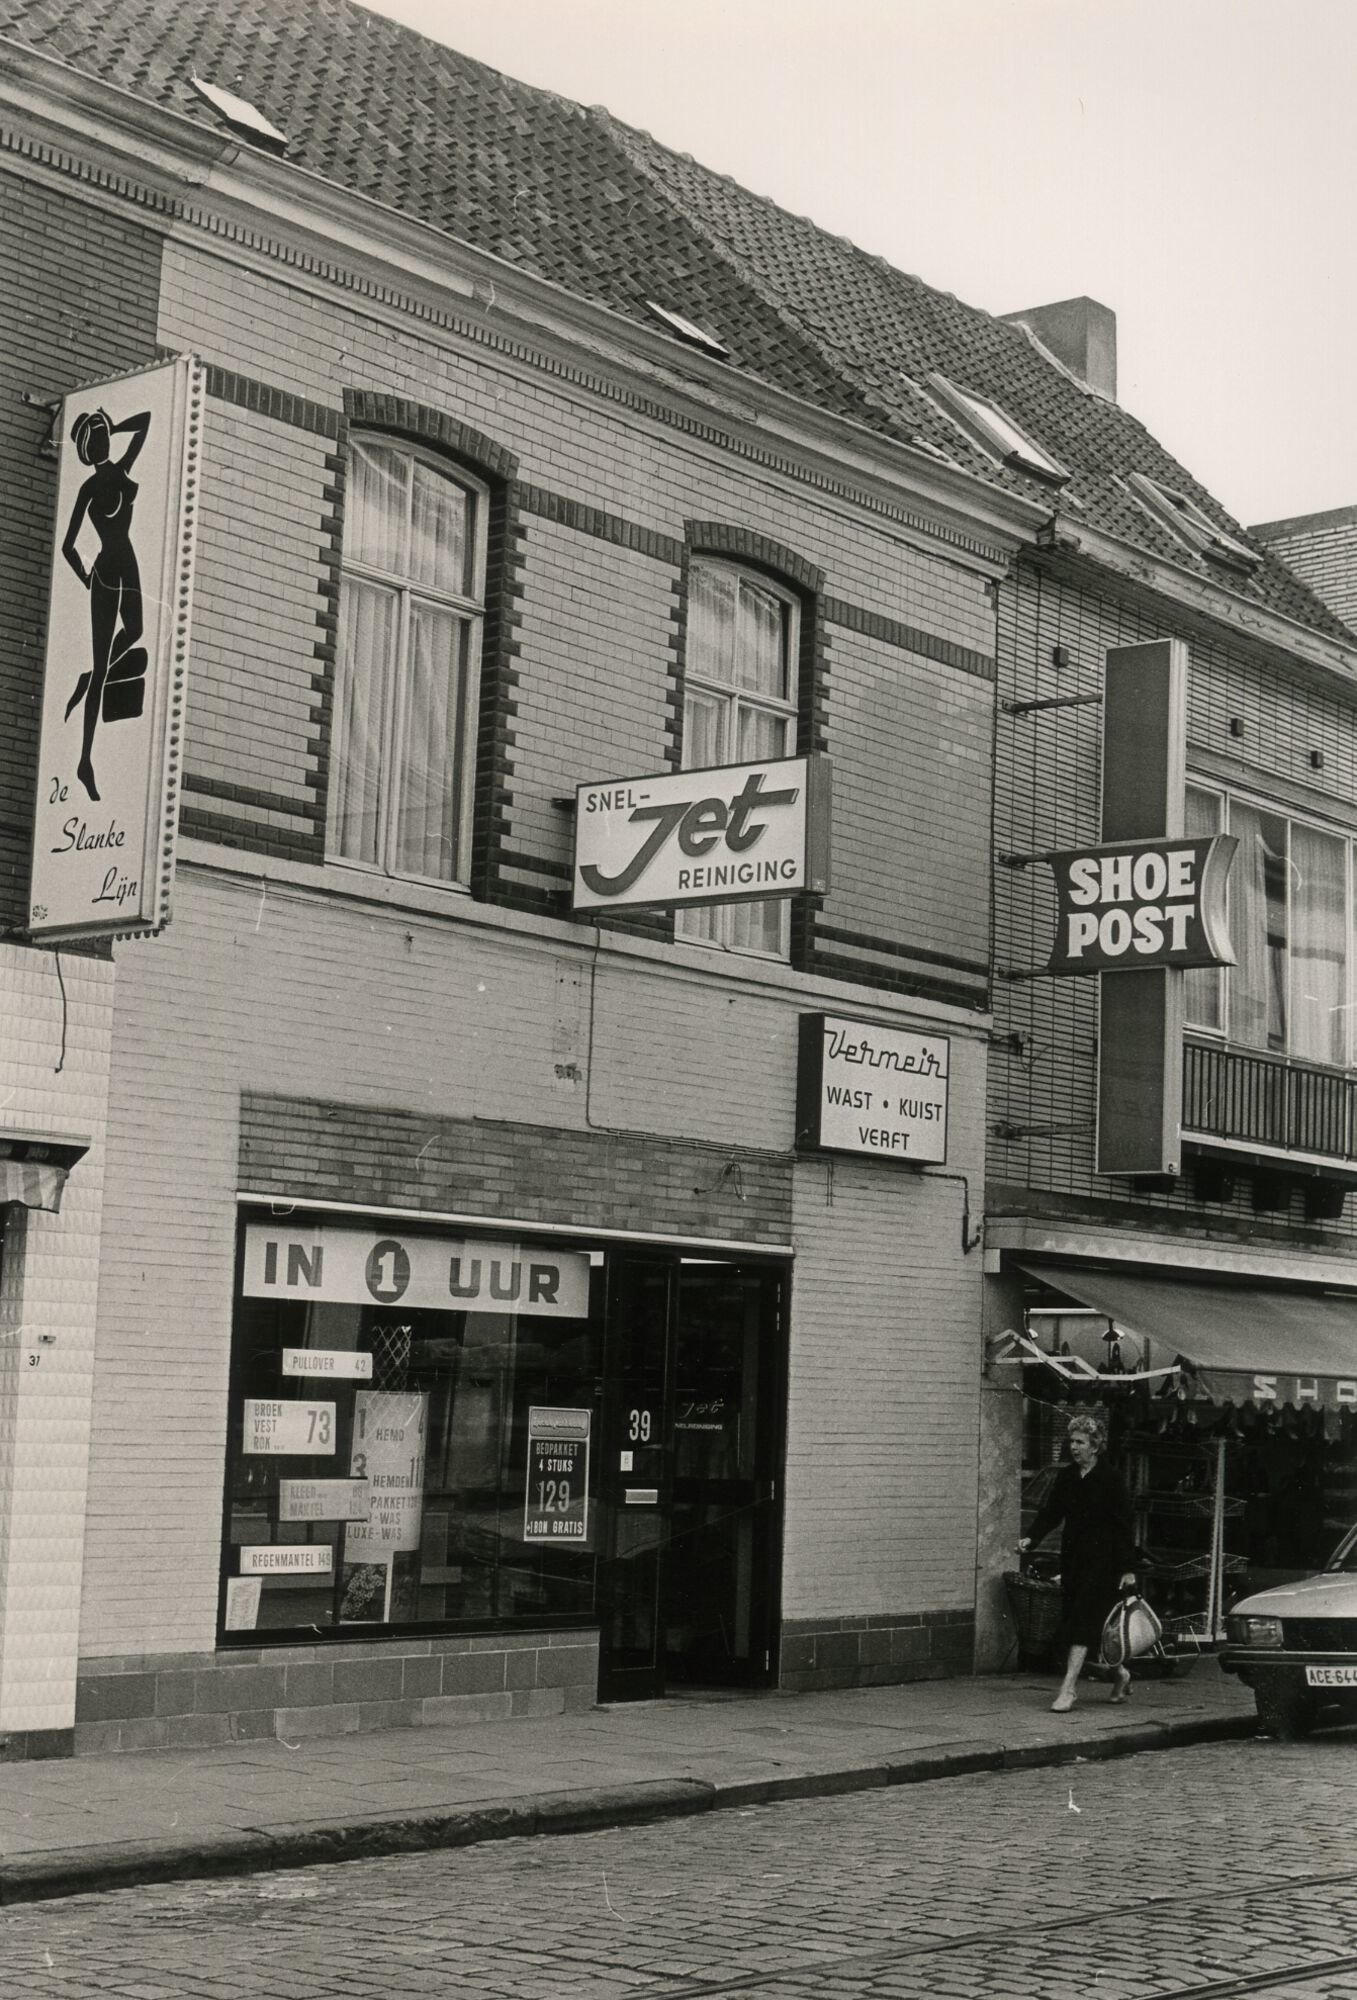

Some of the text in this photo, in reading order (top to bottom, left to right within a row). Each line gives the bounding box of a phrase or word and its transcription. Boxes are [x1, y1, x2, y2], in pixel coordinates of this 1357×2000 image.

[49, 776, 69, 804] de
[585, 788, 651, 813] SNEL-
[50, 816, 126, 853] Slanke
[579, 773, 800, 896] Jet
[91, 866, 138, 906] Lijn
[678, 858, 797, 890] REINIGING
[1068, 850, 1196, 906] SHOE
[1066, 904, 1196, 958] POST
[823, 1029, 948, 1080] Vermeir
[826, 1085, 943, 1122] WAST KUIST
[858, 1126, 910, 1151] VERFT
[264, 1241, 560, 1305] IN 1 UUR
[292, 1355, 367, 1373] PULLOVER 42
[254, 1402, 331, 1445] BROEK 73
[254, 1419, 278, 1434] VEST
[376, 1427, 405, 1442] HEMD
[629, 1409, 651, 1442] 39
[253, 1435, 272, 1450] ROK
[535, 1441, 579, 1457] BEDPAKKET
[538, 1458, 574, 1473] 4 STUKS
[369, 1495, 406, 1510] PAKKET
[538, 1480, 570, 1513] 129
[552, 1520, 584, 1535] GRATIS
[252, 1553, 314, 1568] REGENMANTEL
